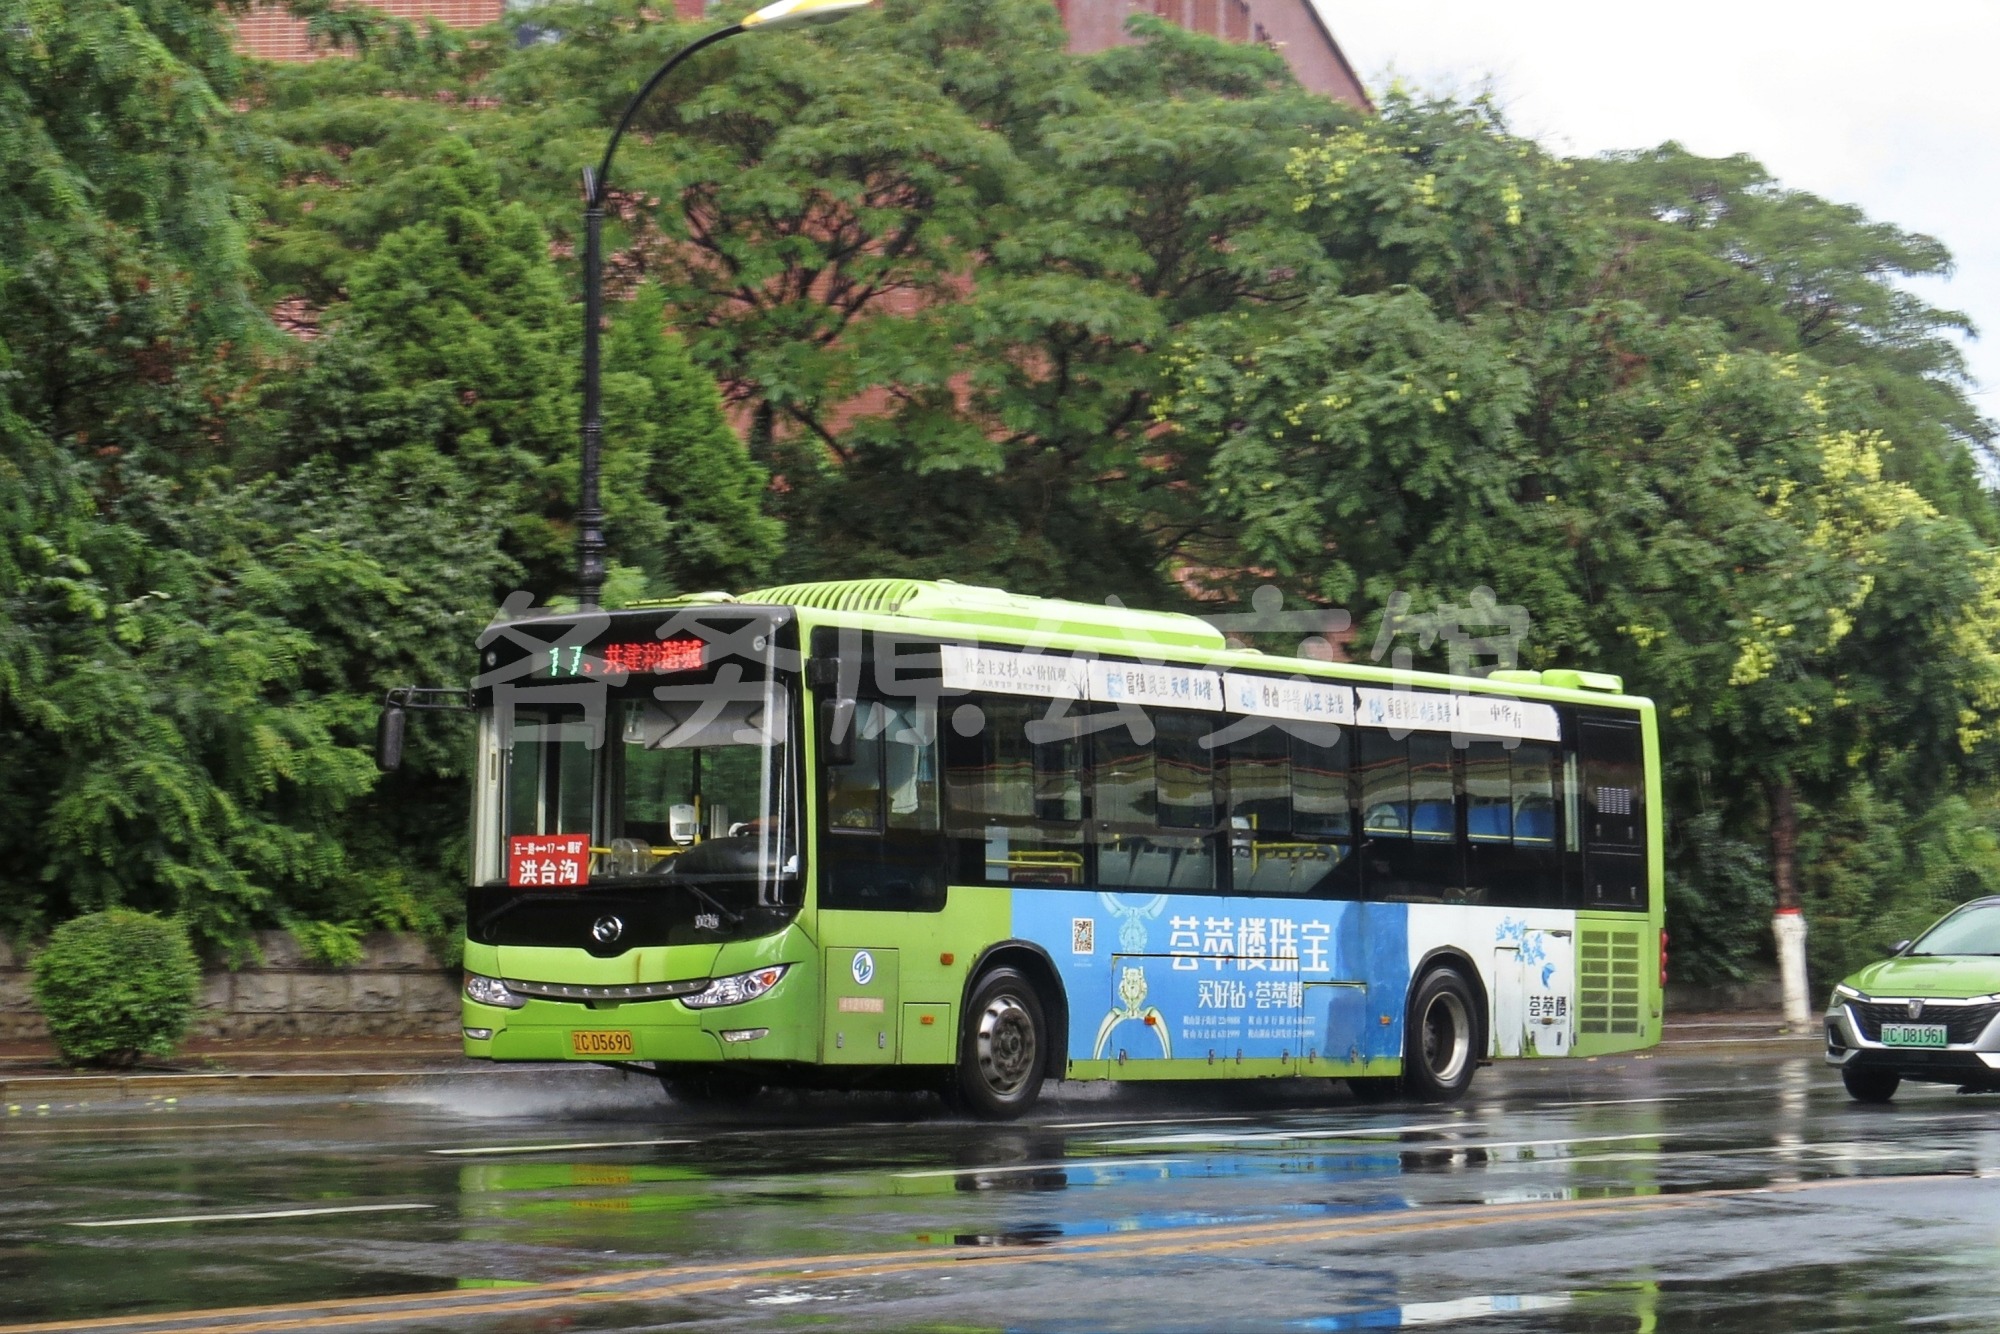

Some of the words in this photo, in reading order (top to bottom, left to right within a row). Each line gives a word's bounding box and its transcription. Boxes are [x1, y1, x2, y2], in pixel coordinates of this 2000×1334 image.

[965, 657, 1068, 682] 社会主义核心价值观
[547, 843, 556, 854] 17
[519, 859, 579, 885] 洪台沟
[1169, 915, 1331, 972] 荟萃楼珠宝
[1529, 995, 1567, 1017] 荟萃楼
